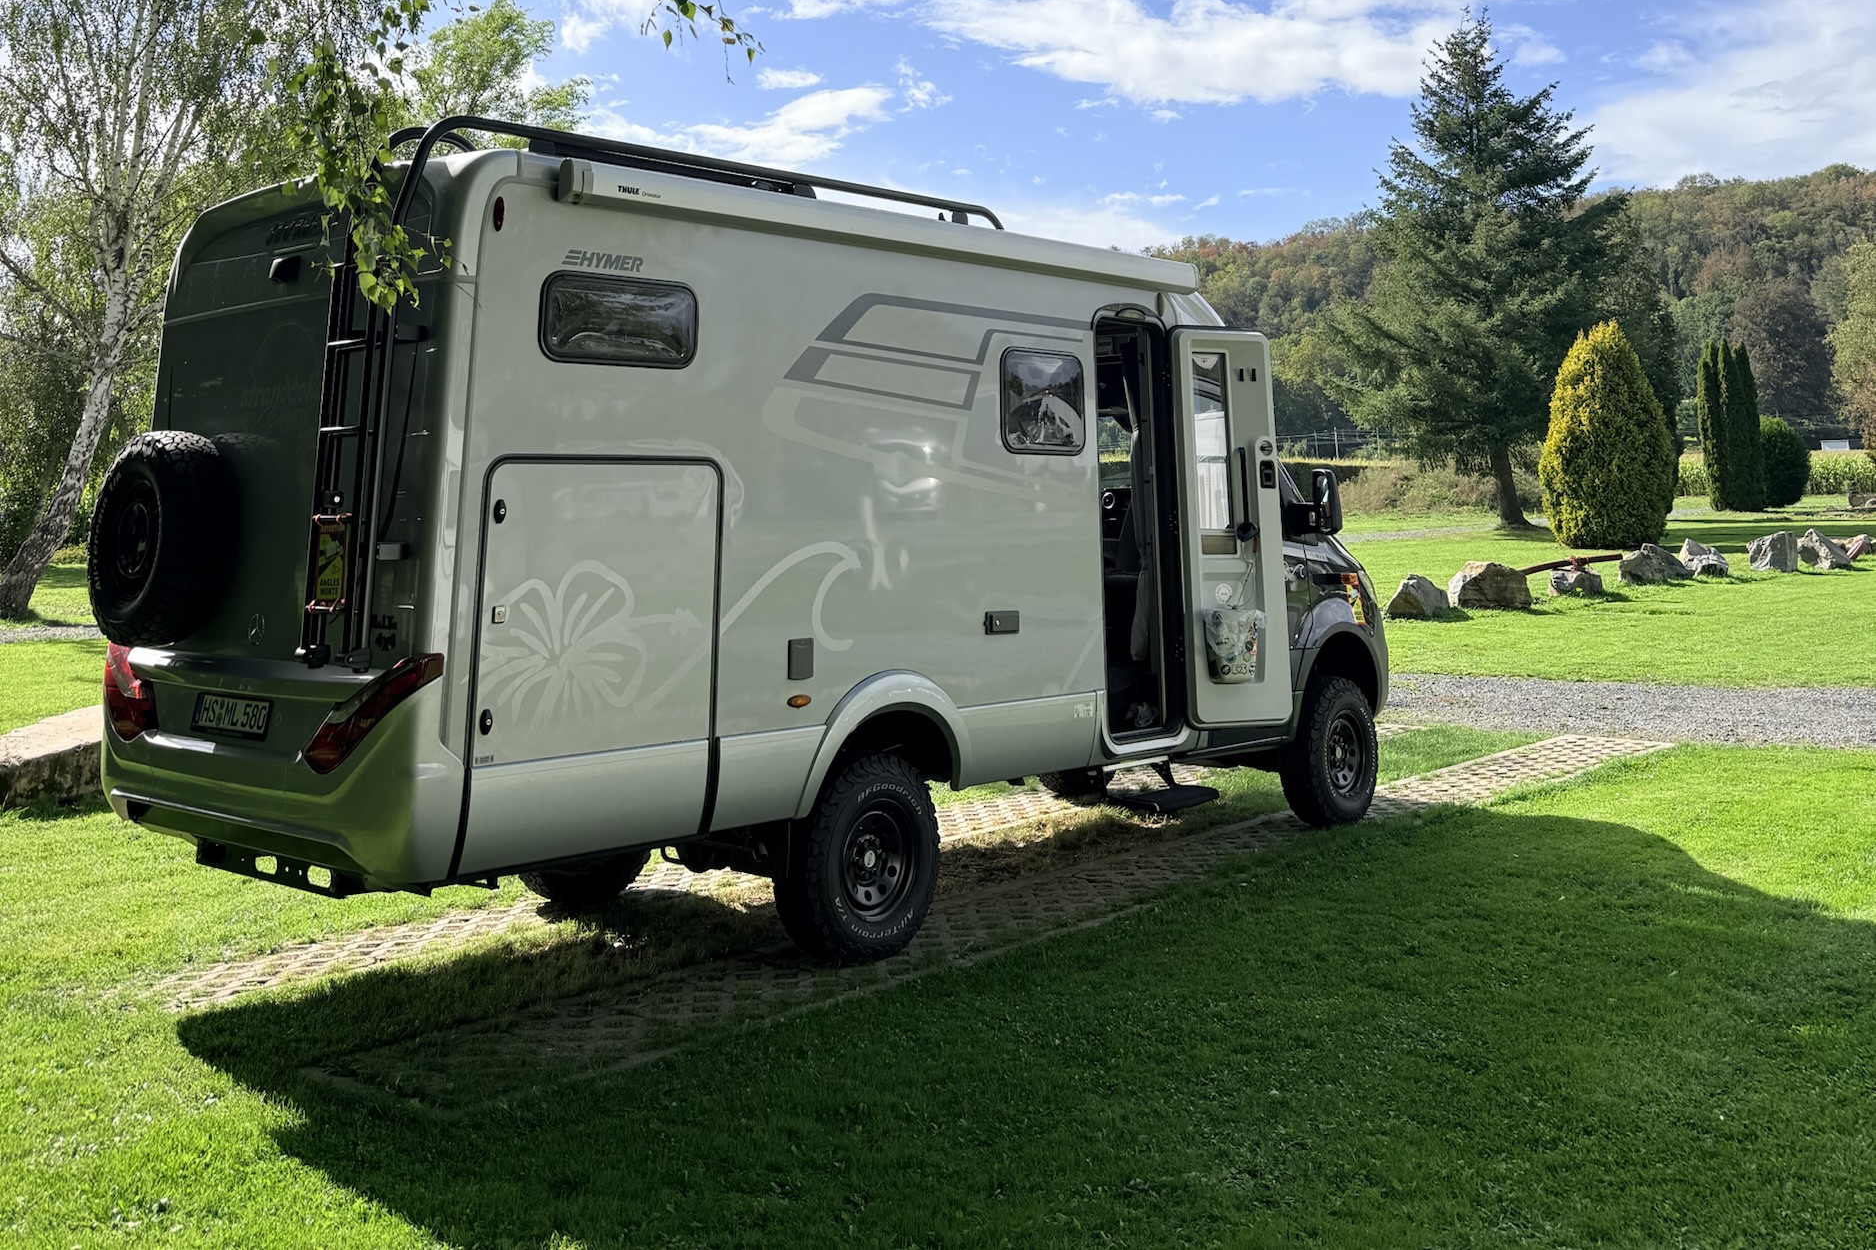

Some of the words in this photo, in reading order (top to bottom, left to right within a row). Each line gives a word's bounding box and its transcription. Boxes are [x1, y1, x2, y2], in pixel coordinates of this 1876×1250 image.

[617, 184, 640, 196] THULE
[578, 250, 644, 273] HYMER
[319, 577, 340, 587] ANGLES
[319, 586, 339, 596] MORTS
[200, 696, 219, 723] HS
[222, 700, 240, 727] ML
[240, 703, 267, 731] 580
[857, 782, 923, 816] BFGoodrich
